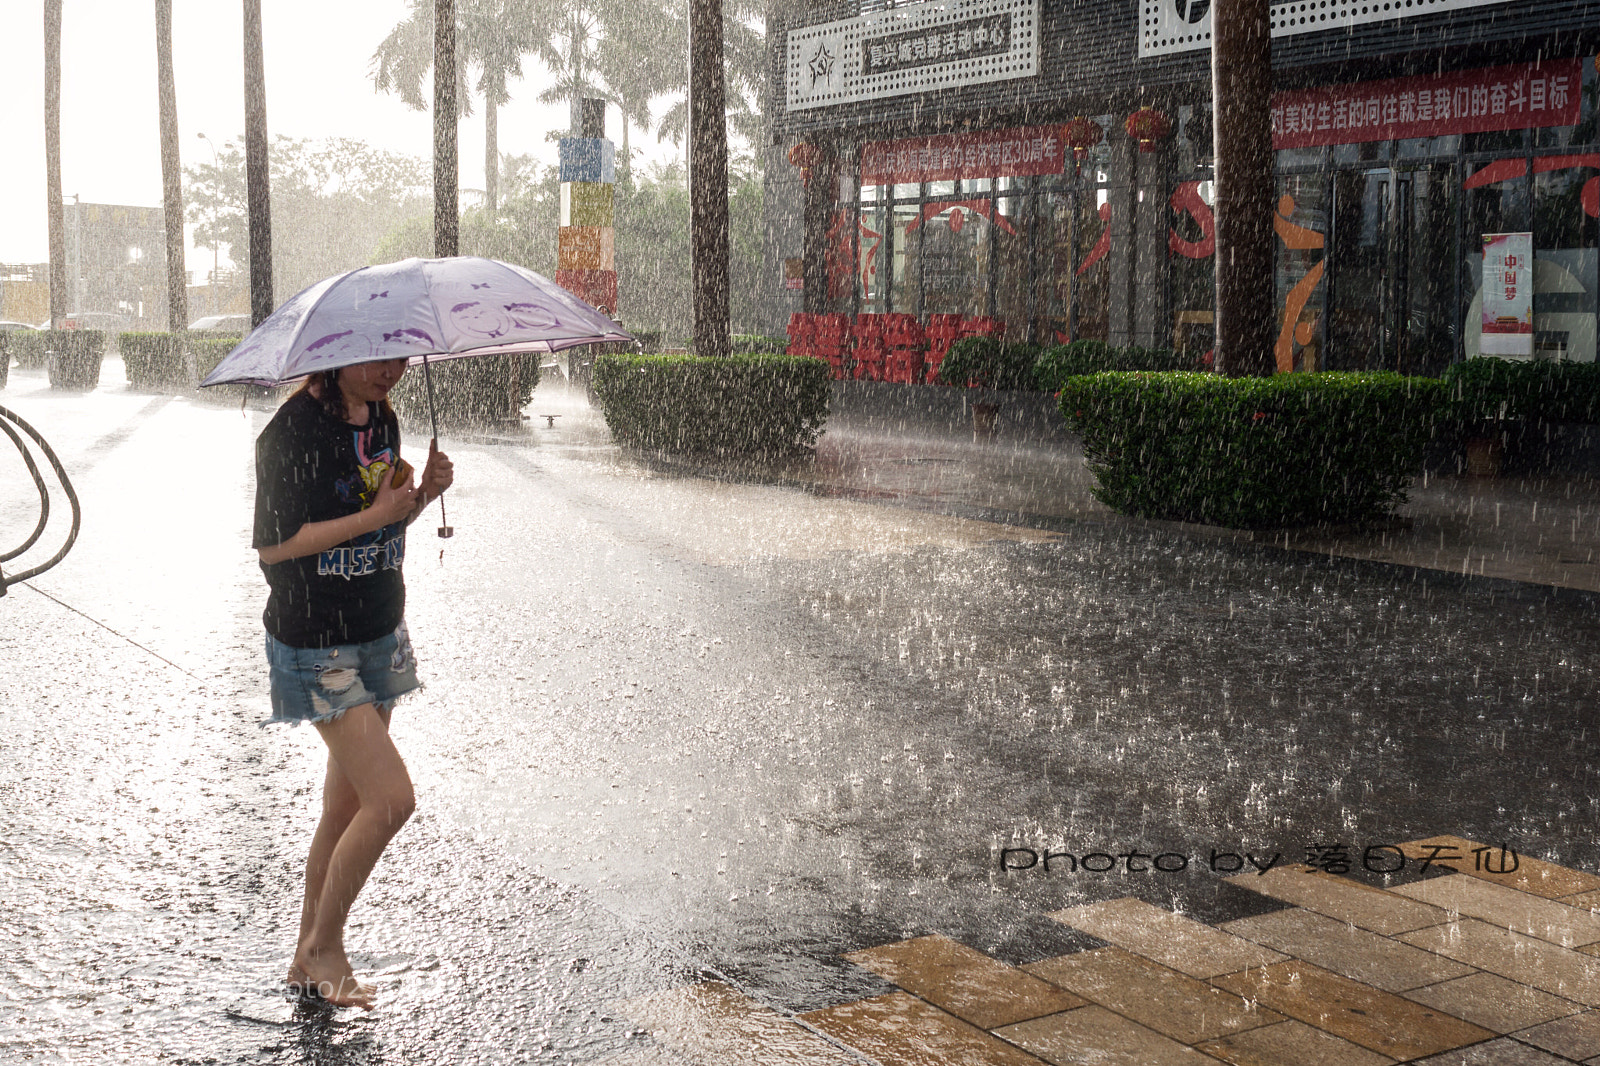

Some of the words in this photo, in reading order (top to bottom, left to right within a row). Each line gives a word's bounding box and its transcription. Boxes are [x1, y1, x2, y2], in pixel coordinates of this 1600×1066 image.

[1505, 254, 1517, 301] 中国梦
[318, 546, 379, 581] MISS
